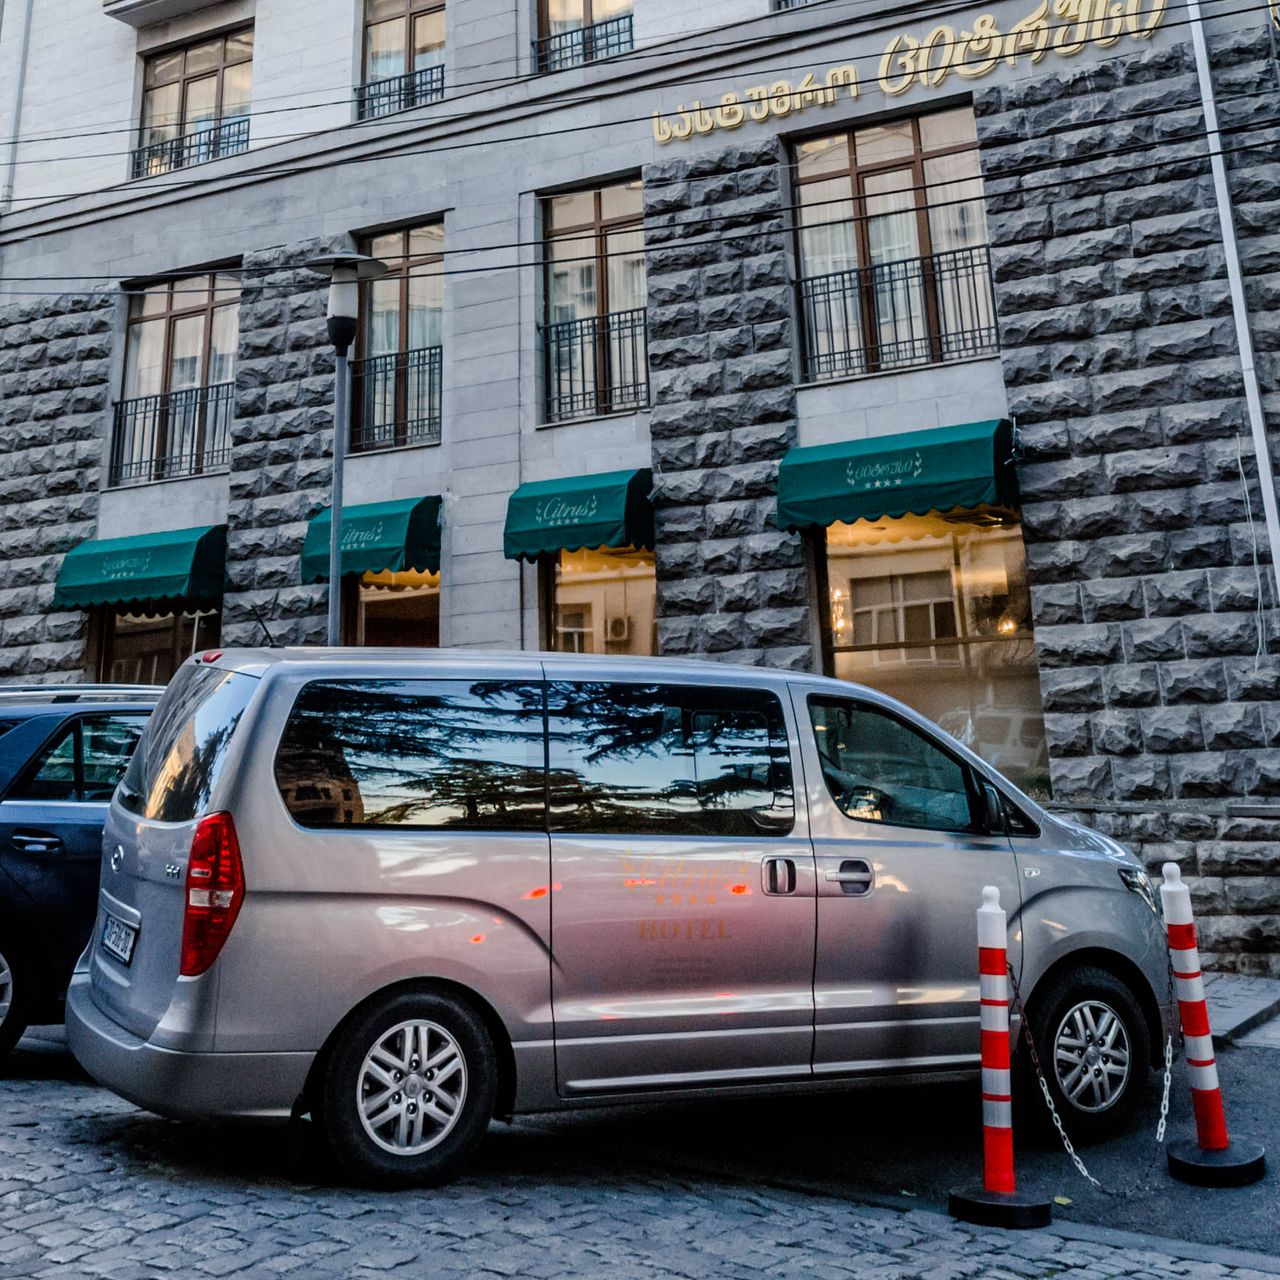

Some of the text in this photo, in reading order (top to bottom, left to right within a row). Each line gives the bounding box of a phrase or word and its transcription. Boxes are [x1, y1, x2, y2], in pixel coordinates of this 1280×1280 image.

[652, 64, 860, 144] სასტუმრო
[543, 497, 589, 520] Citrus
[342, 524, 376, 544] itrus
